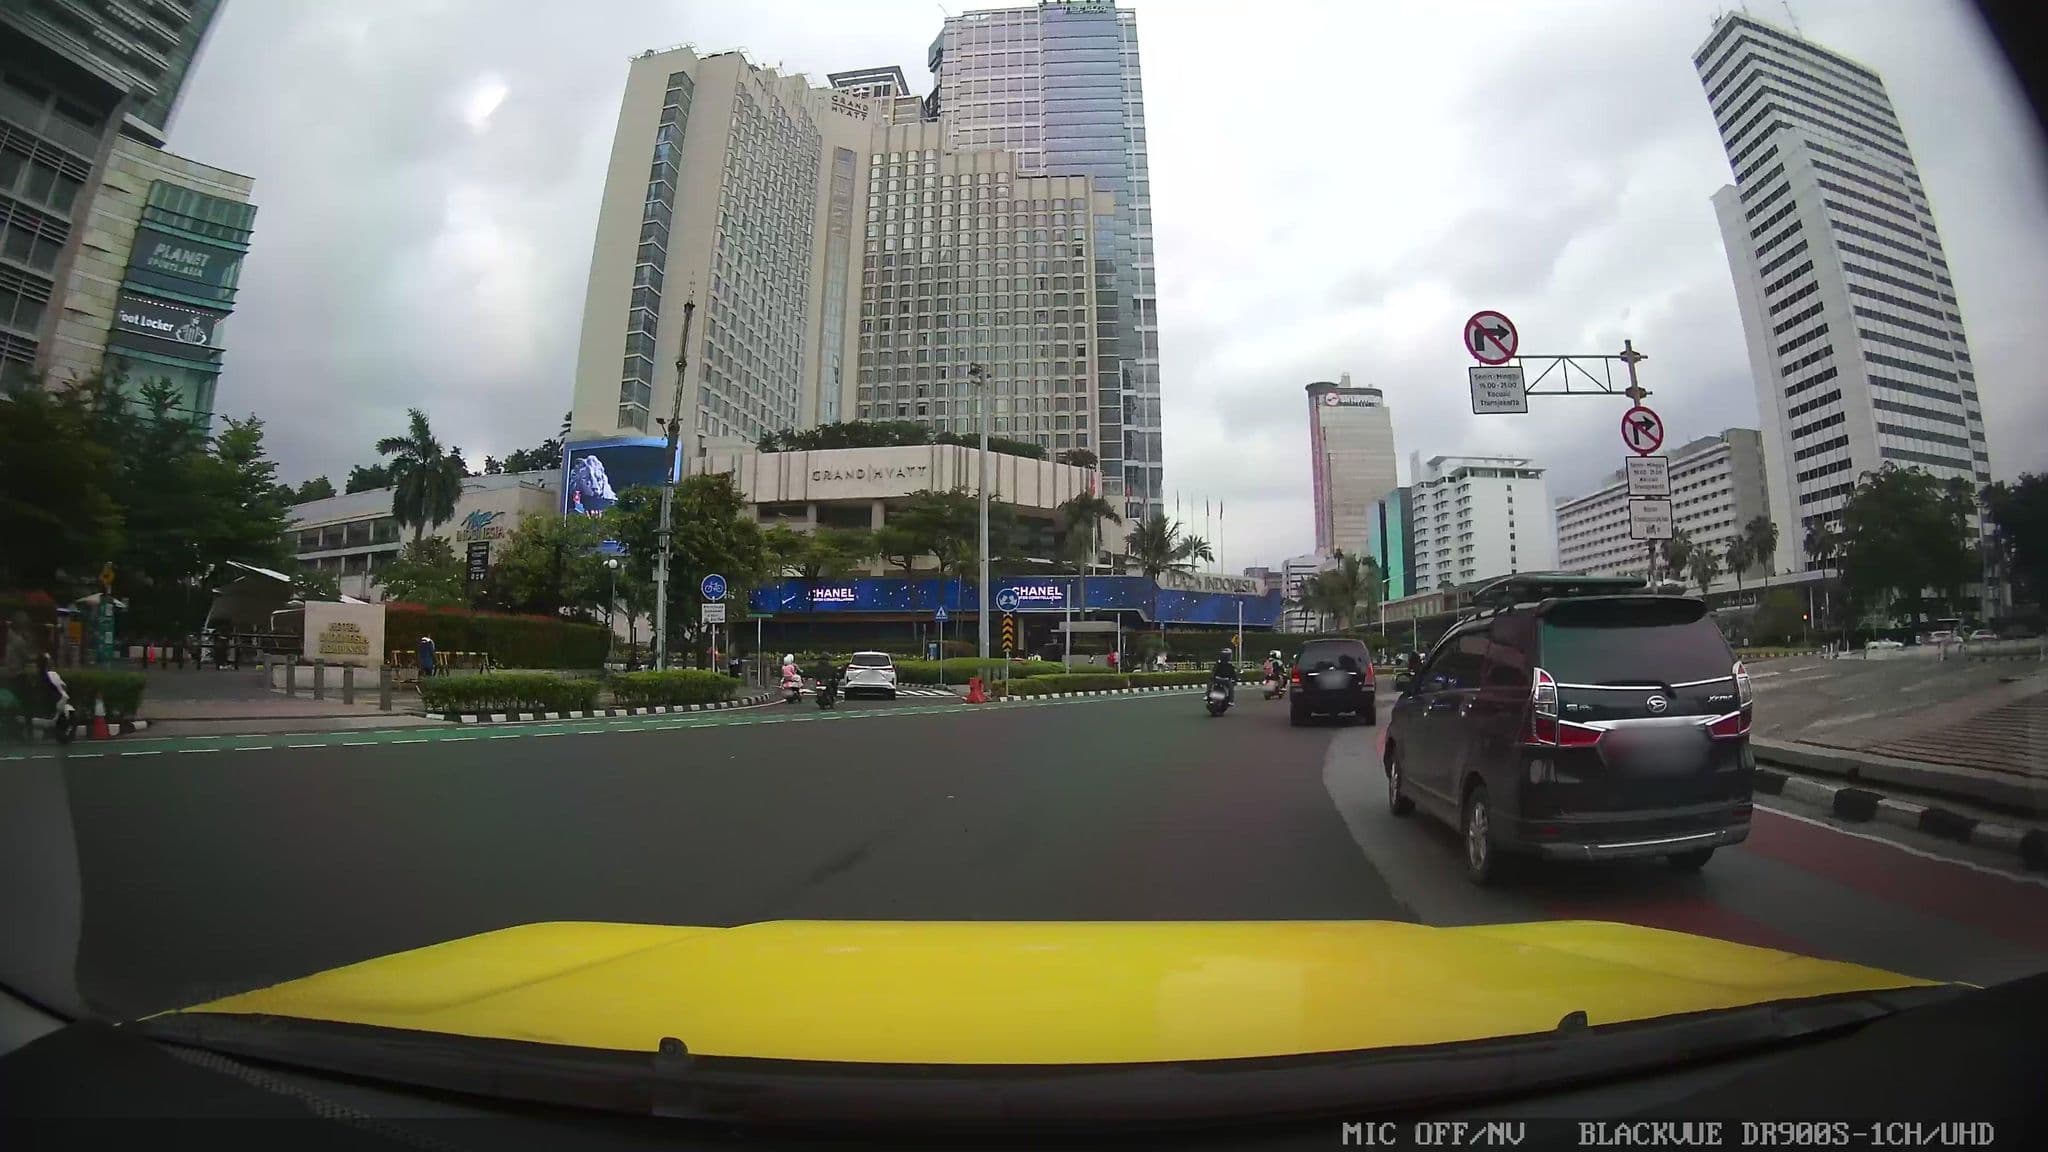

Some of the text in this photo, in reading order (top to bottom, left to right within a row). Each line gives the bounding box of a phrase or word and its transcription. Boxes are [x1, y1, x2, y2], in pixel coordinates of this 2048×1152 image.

[832, 95, 869, 111] GRAND
[832, 106, 867, 121] HYATT
[153, 243, 210, 267] PLANET
[140, 315, 174, 332] Locker
[812, 466, 926, 481] GRAND HYATT
[1204, 576, 1258, 593] INDONESIA
